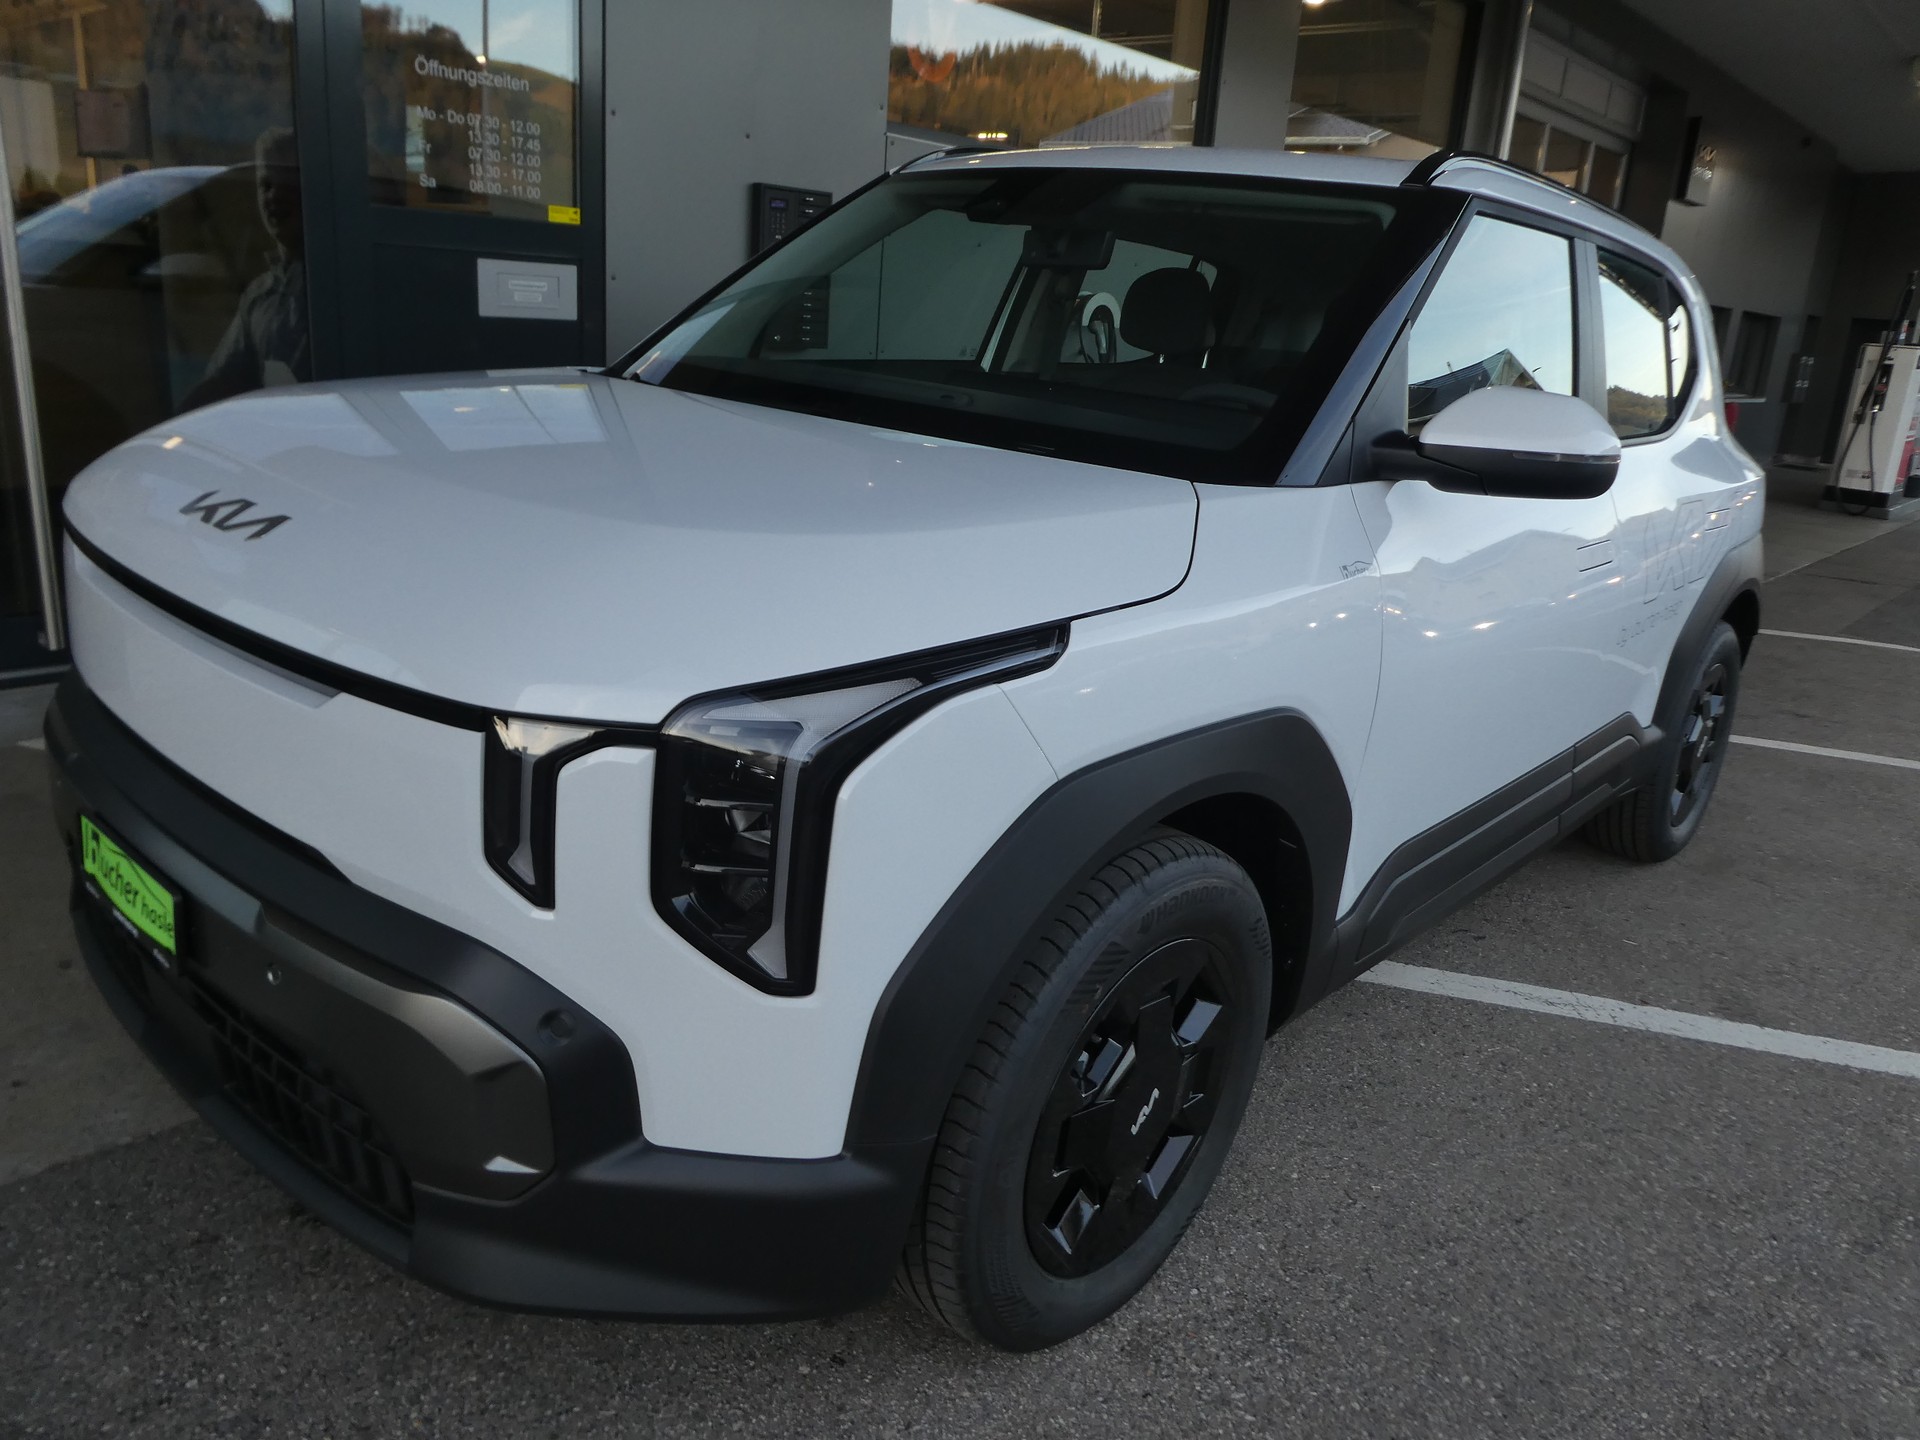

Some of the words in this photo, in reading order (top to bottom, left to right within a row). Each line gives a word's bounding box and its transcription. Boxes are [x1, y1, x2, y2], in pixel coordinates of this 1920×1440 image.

[414, 54, 530, 92] Öffnungszeiten
[417, 106, 437, 121] Mo
[447, 109, 466, 125] Do
[510, 120, 541, 136] 12.00
[511, 136, 541, 152] 17.45
[510, 152, 541, 168] 12.00
[420, 173, 437, 188] Sa
[469, 180, 502, 196] 08.00
[511, 184, 541, 200] 11.00
[511, 168, 541, 184] 17.00
[179, 489, 292, 541] KIA
